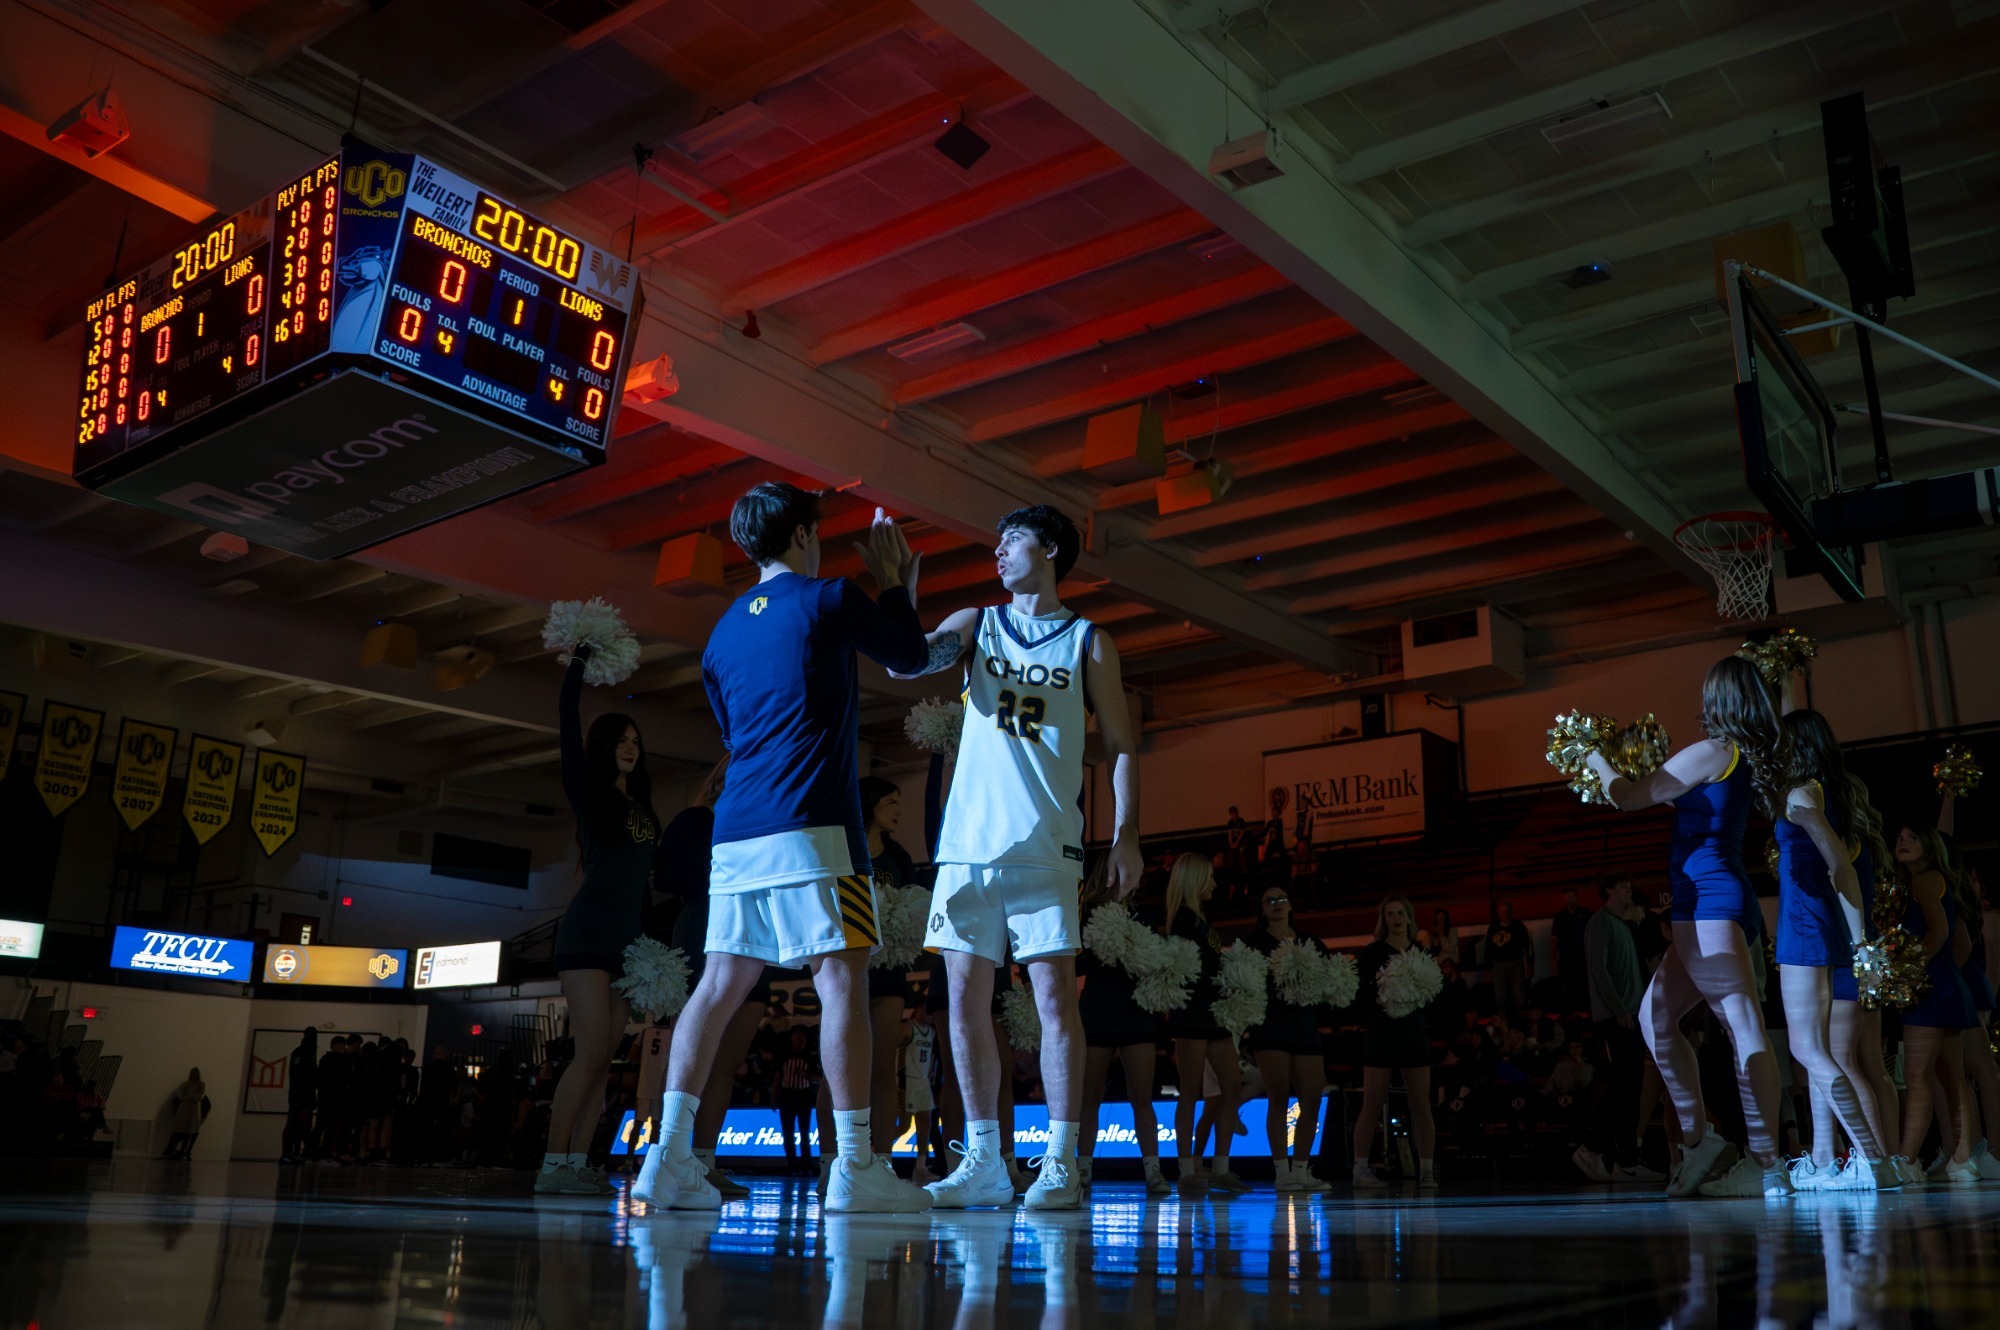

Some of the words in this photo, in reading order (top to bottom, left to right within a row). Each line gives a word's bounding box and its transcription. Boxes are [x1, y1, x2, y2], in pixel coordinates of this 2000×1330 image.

[301, 176, 314, 196] FL
[316, 161, 338, 187] PTS
[344, 160, 406, 208] UCO
[416, 161, 437, 180] THE
[291, 210, 297, 228] 1
[300, 200, 312, 224] 0
[324, 186, 336, 210] 0
[411, 176, 473, 217] WEILERT
[343, 208, 399, 219] BRONCHOS
[431, 207, 468, 231] FAMILY
[285, 235, 295, 258] 2
[298, 226, 311, 250] 0
[322, 213, 334, 236] 0
[413, 214, 493, 270] BRONCHOS
[473, 199, 580, 279] 20:00
[172, 222, 237, 289] 20:00
[224, 256, 254, 286] LIONS
[284, 263, 293, 286] 3
[296, 255, 308, 278] 0
[321, 241, 332, 265] 0
[118, 281, 136, 303] PTS
[247, 274, 264, 315] 0
[282, 291, 292, 308] 4
[295, 282, 307, 305] 0
[319, 268, 331, 292] 0
[391, 284, 431, 311] FOULS
[438, 259, 468, 304] 0
[499, 268, 539, 297] PERIOD
[140, 295, 184, 333] BRONCHOS
[275, 319, 290, 342] 16
[293, 310, 304, 334] 0
[318, 298, 329, 322] 0
[514, 300, 524, 324] 1
[560, 288, 603, 321] LIONS
[94, 321, 102, 341] 5
[104, 314, 114, 335] 0
[123, 304, 134, 324] 0
[198, 313, 204, 336] 1
[399, 308, 423, 342] 0
[438, 314, 459, 333] T.O.L.
[88, 345, 103, 365] 12
[101, 338, 113, 358] 0
[121, 327, 132, 348] 0
[155, 326, 171, 364] 0
[246, 334, 259, 366] 0
[380, 339, 421, 367] SCORE
[438, 331, 453, 353] 4
[468, 317, 497, 342] FOUL
[502, 332, 545, 363] PLAYER
[590, 330, 616, 370] 0
[86, 370, 100, 391] 15
[99, 364, 111, 384] 0
[119, 353, 130, 374] 0
[223, 356, 232, 373] 4
[577, 367, 611, 391] FOULS
[81, 395, 99, 418] 21
[98, 387, 109, 408] 0
[118, 377, 129, 398] 0
[138, 391, 150, 420] 0
[158, 390, 166, 406] 4
[461, 374, 528, 411] ADVANTAGE
[549, 379, 564, 400] 4
[584, 388, 604, 419] 0
[79, 419, 97, 443] 22
[96, 413, 107, 434] 0
[116, 403, 127, 424] 0
[565, 417, 600, 441] SCORE
[243, 416, 440, 505] paycom
[986, 656, 1071, 691] CHOS
[52, 716, 91, 748] UCO
[996, 688, 1047, 744] 22
[127, 734, 165, 766] UCO
[198, 750, 233, 780] UCO
[43, 782, 78, 797] 2003
[263, 762, 296, 792] UCO
[1294, 777, 1348, 811] F&M
[1354, 768, 1419, 803] Bank
[121, 797, 154, 812] 2007
[192, 811, 222, 826] 2023
[259, 822, 286, 836] 2024
[140, 932, 228, 962] TFCU
[368, 954, 398, 980] UCO
[651, 1038, 661, 1055] 5
